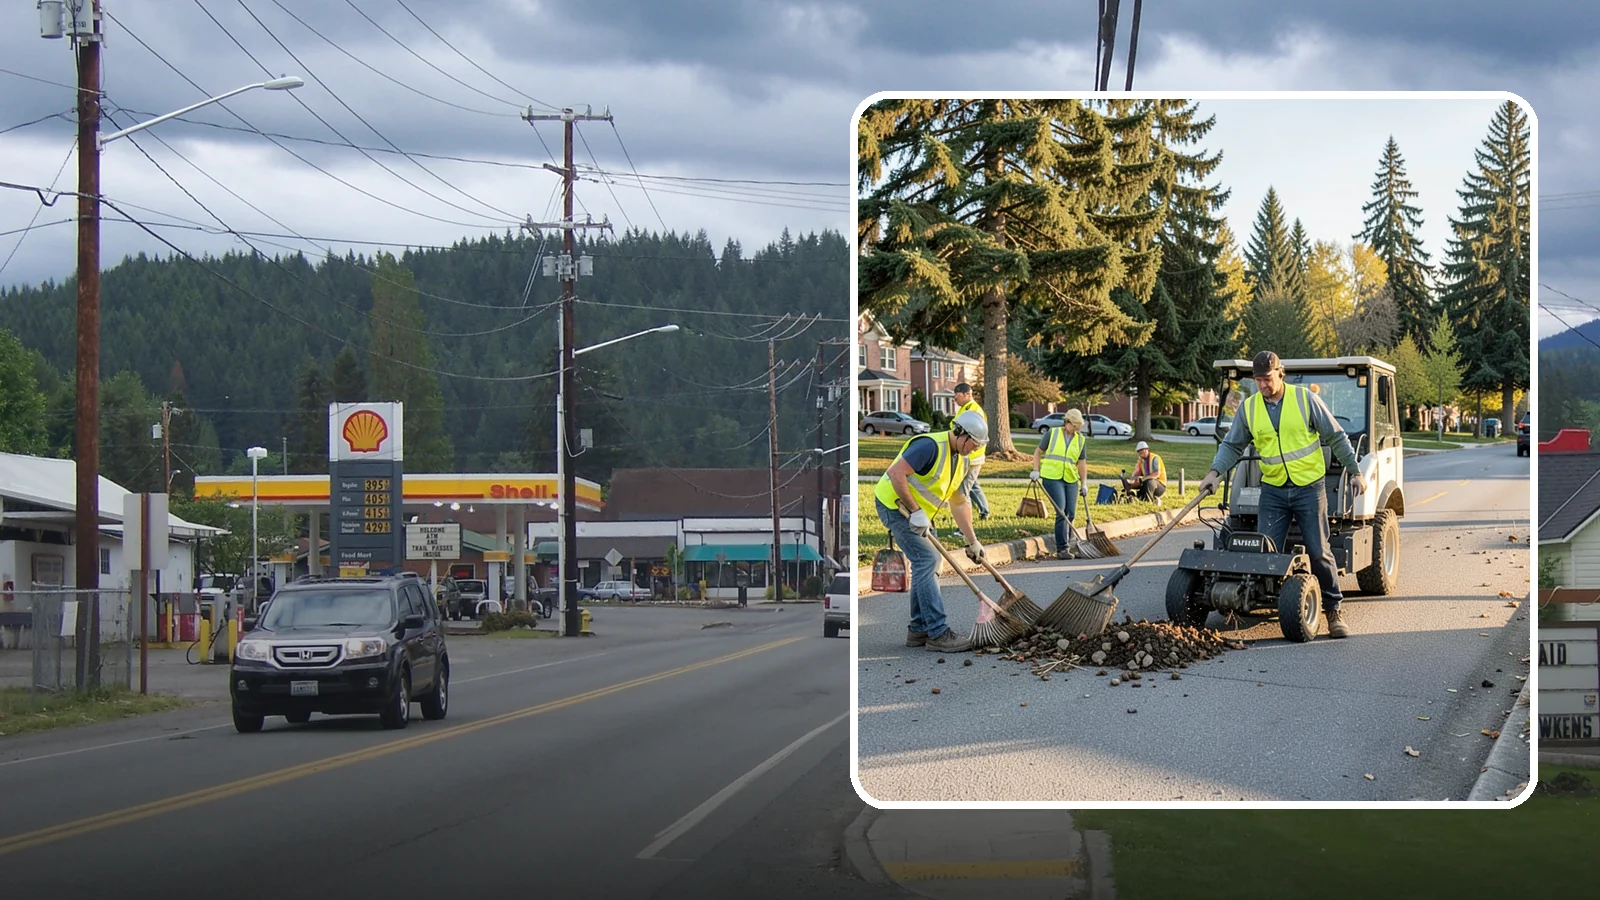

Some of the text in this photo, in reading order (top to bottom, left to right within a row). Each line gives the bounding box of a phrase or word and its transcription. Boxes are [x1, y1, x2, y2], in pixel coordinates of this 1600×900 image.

[365, 480, 383, 490] 395
[490, 484, 547, 499] Shell
[365, 494, 383, 504] 405
[365, 508, 383, 518] 415
[365, 522, 383, 532] 429
